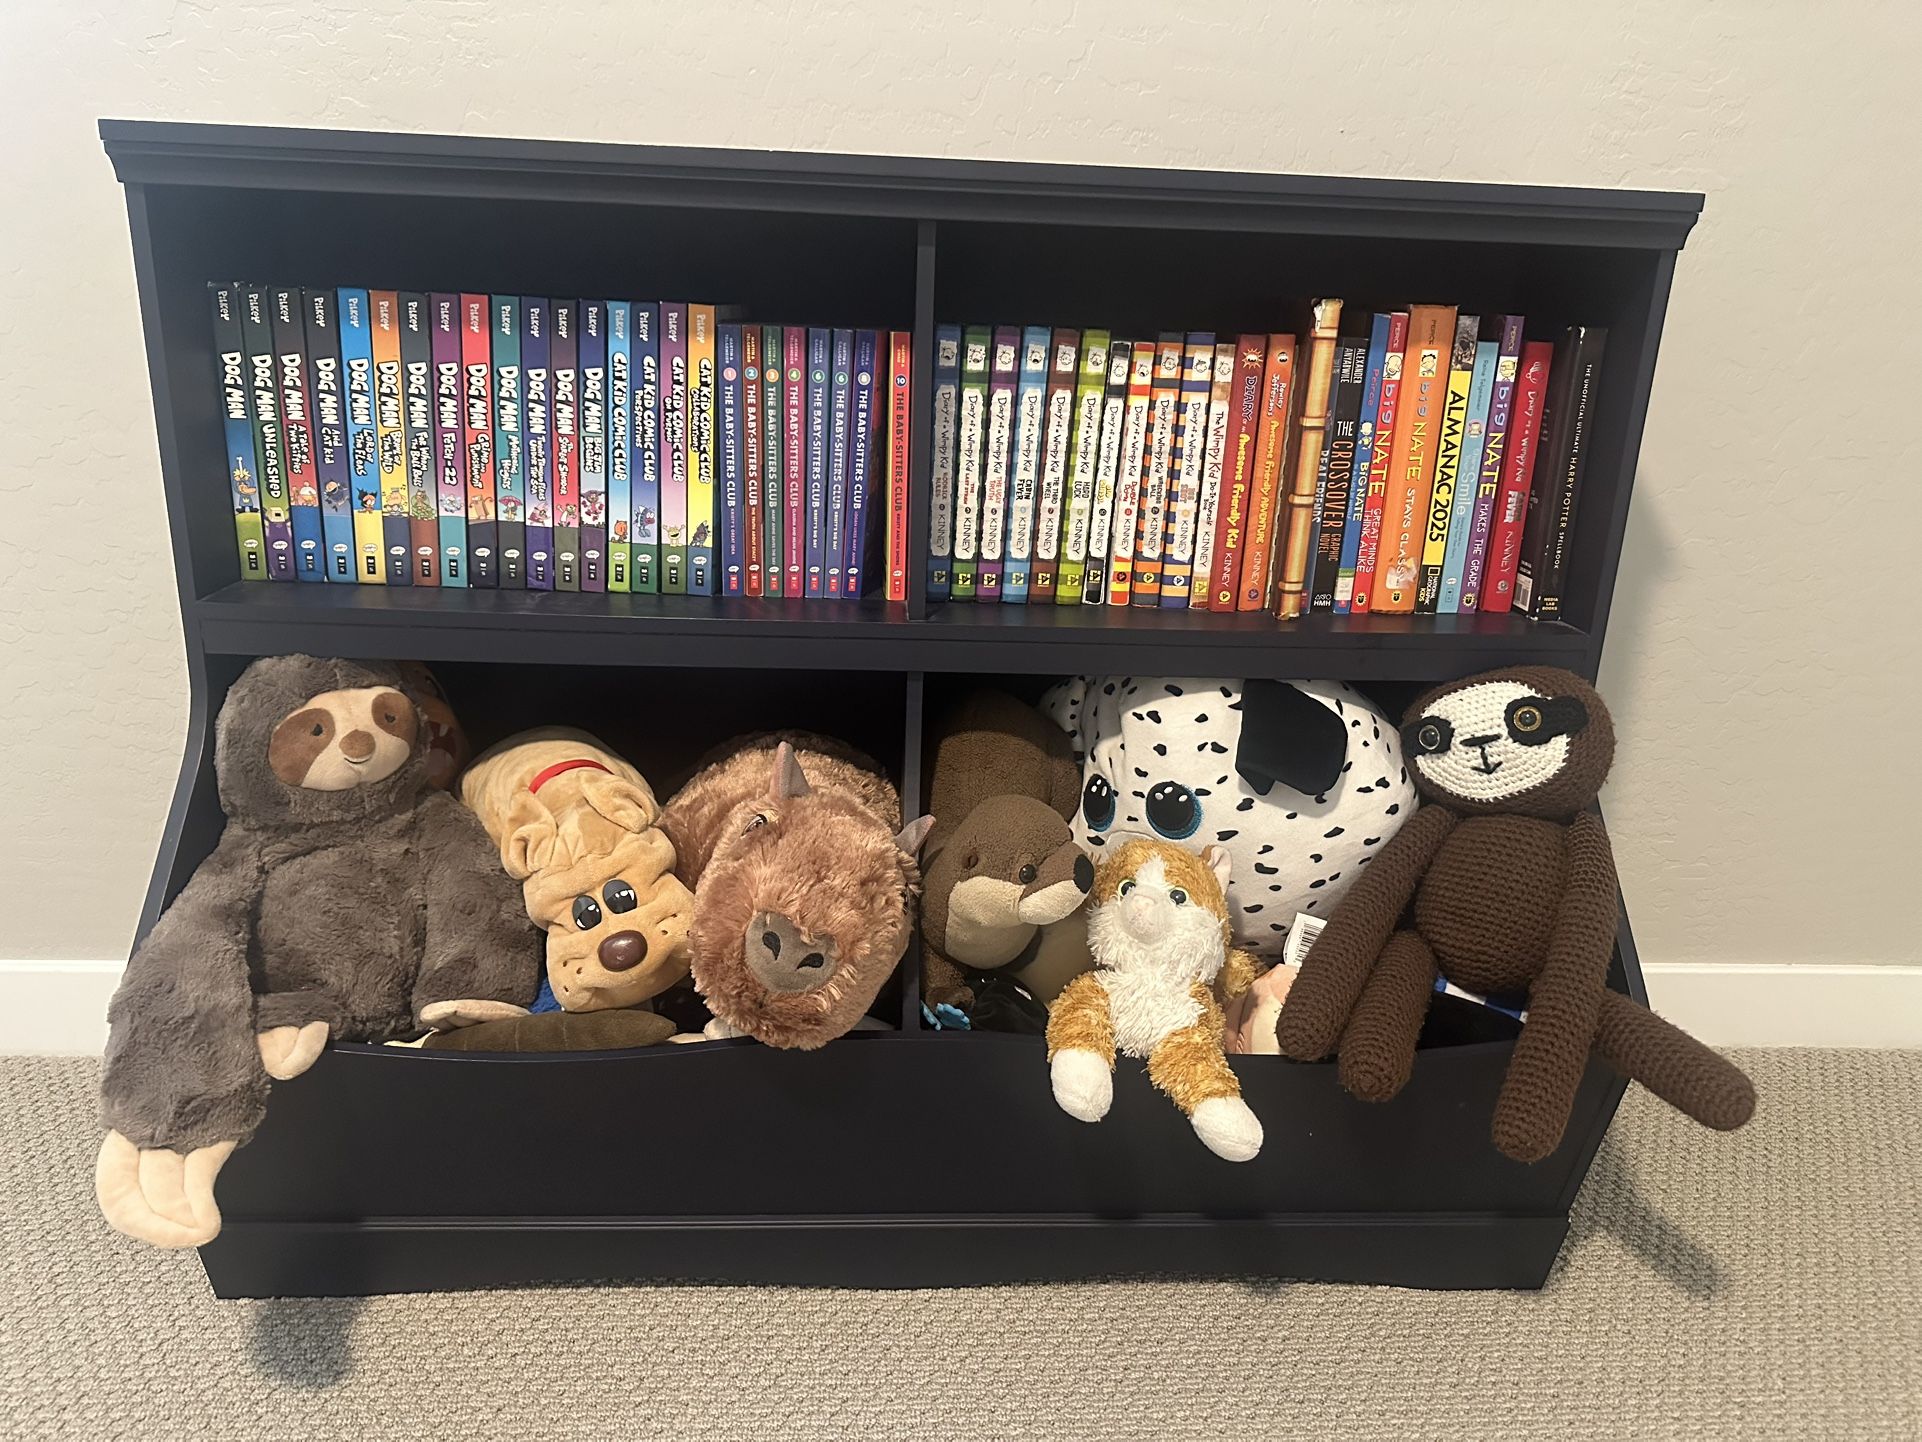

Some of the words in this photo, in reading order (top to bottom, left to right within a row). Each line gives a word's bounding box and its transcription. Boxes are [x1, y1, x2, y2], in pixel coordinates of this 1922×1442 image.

[222, 352, 242, 385] DOG
[252, 354, 272, 388] DOG
[280, 354, 302, 386] DOG
[316, 358, 336, 391] DOG
[348, 358, 369, 392] DOG
[378, 362, 399, 395] DOG
[407, 362, 428, 395] DOG
[438, 362, 458, 396] DOG
[468, 364, 488, 398] DOG
[614, 352, 627, 379] CAT
[644, 356, 655, 382] CAT
[672, 356, 684, 382] CAT
[700, 358, 712, 386] CAT
[790, 370, 796, 378] 4
[815, 372, 822, 380] 6
[838, 374, 844, 382] 6
[1353, 348, 1366, 384] ALEXANDER
[1584, 364, 1592, 377] THE
[498, 366, 518, 398] DOG
[528, 368, 547, 402] DOG
[556, 369, 574, 402] DOG
[584, 368, 603, 401] DOG
[725, 385, 734, 404] THE
[747, 384, 756, 404] THE
[768, 386, 776, 406] THE
[790, 386, 798, 406] THE
[814, 388, 822, 407] THE
[1368, 368, 1380, 407] Peirce
[226, 387, 247, 418] MAN
[255, 390, 276, 420] MAN
[284, 388, 306, 420] MAN
[318, 392, 340, 424] MAN
[352, 392, 372, 424] MAN
[381, 396, 402, 428] MAN
[409, 396, 428, 428] MAN
[440, 396, 458, 428] MAN
[469, 398, 488, 430] MAN
[836, 389, 845, 408] THE
[858, 390, 868, 410] THE
[896, 392, 904, 411] THE
[968, 395, 978, 422] Diary
[998, 397, 1008, 424] Diary
[1027, 396, 1038, 422] Diary
[1055, 396, 1066, 422] Diary
[1085, 398, 1096, 424] Diary
[1159, 400, 1170, 429] Diary
[1242, 376, 1258, 422] DIARY
[1382, 384, 1396, 424] big
[1417, 382, 1430, 418] big
[1494, 386, 1510, 426] big
[1578, 378, 1589, 420] UNOFFICIAL
[500, 400, 518, 432] MAN
[528, 402, 546, 434] MAN
[556, 402, 574, 434] MAN
[584, 401, 602, 434] MAN
[1108, 406, 1118, 431] Diary
[1133, 406, 1143, 430] Diary
[1190, 402, 1200, 431] Diary
[1215, 412, 1224, 426] The
[1337, 420, 1354, 437] THE
[726, 408, 735, 478] BABY-SITTERS
[748, 407, 757, 478] BABY-SITTERS
[768, 409, 777, 480] BABY-SITTERS
[790, 408, 798, 478] BABY-SITTERS
[812, 410, 822, 480] BABY-SITTERS
[834, 412, 844, 482] BABY-SITTERS
[854, 412, 866, 481] BABY-SITTERS
[895, 414, 904, 484] BABY-SITTERS
[966, 433, 976, 462] Wimpy
[993, 436, 1004, 462] Wimpy
[1023, 434, 1034, 461] Wimpy
[1050, 434, 1060, 460] Wimpy
[1080, 436, 1091, 461] Wimpy
[1128, 440, 1138, 465] Wimpy
[1154, 436, 1165, 464] Wimpy
[1186, 438, 1196, 465] Wimpy
[1208, 425, 1224, 461] Wimpy
[1406, 422, 1428, 481] NATE
[1436, 390, 1466, 494] ALMANAC
[1572, 421, 1582, 454] ULTIMATE
[614, 450, 626, 480] CLUB
[644, 451, 655, 482] CLUB
[673, 452, 684, 482] CLUB
[700, 454, 711, 484] CLUB
[966, 460, 974, 472] Kid
[994, 462, 1002, 474] Kid
[1023, 460, 1032, 472] Kid
[1050, 460, 1060, 473] Kid
[1080, 462, 1090, 474] Kid
[1103, 440, 1114, 468] Wimpy
[1154, 462, 1164, 474] Kid
[1368, 430, 1392, 498] NATE
[1479, 432, 1504, 499] NATE
[1208, 462, 1221, 480] Kid
[1322, 441, 1354, 528] CROSSOVER
[1566, 457, 1578, 488] HARRY
[727, 481, 736, 506] CLUB
[748, 480, 758, 506] CLUB
[769, 482, 777, 508] CLUB
[790, 481, 798, 507] CLUB
[812, 482, 820, 508] CLUB
[833, 484, 842, 509] CLUB
[853, 484, 862, 509] CLUB
[894, 486, 902, 512] CLUB
[1016, 479, 1026, 500] FEVER
[1353, 488, 1366, 522] NATE
[1456, 472, 1476, 516] Smile
[1402, 488, 1416, 528] STAYS
[1429, 498, 1450, 542] 2025
[1476, 503, 1488, 533] MAKES
[1504, 490, 1518, 524] FEVER
[1560, 492, 1571, 528] POTTER
[962, 517, 972, 553] KINNEY
[988, 518, 998, 554] KINNEY
[1016, 516, 1026, 552] KINNEY
[1044, 518, 1054, 554] KINNEY
[1073, 518, 1084, 554] KINNEY
[1097, 519, 1105, 552] KINNEY
[1121, 518, 1130, 552] KINNEY
[1148, 518, 1158, 553] KINNEY
[1178, 520, 1188, 554] KINNEY
[1360, 509, 1374, 538] THINK
[1371, 508, 1382, 540] GREAT
[1200, 531, 1211, 568] KINNEY
[1318, 533, 1330, 554] NOVEL
[1328, 533, 1342, 561] GRAPHIC
[1356, 540, 1368, 572] ALIKE
[1366, 542, 1378, 572] MINDS
[1472, 538, 1484, 555] THE
[1554, 532, 1564, 569] SPELLBOOK
[1222, 552, 1232, 587] KINNEY
[1251, 552, 1262, 586] KINNEY
[1468, 560, 1480, 588] GRADE
